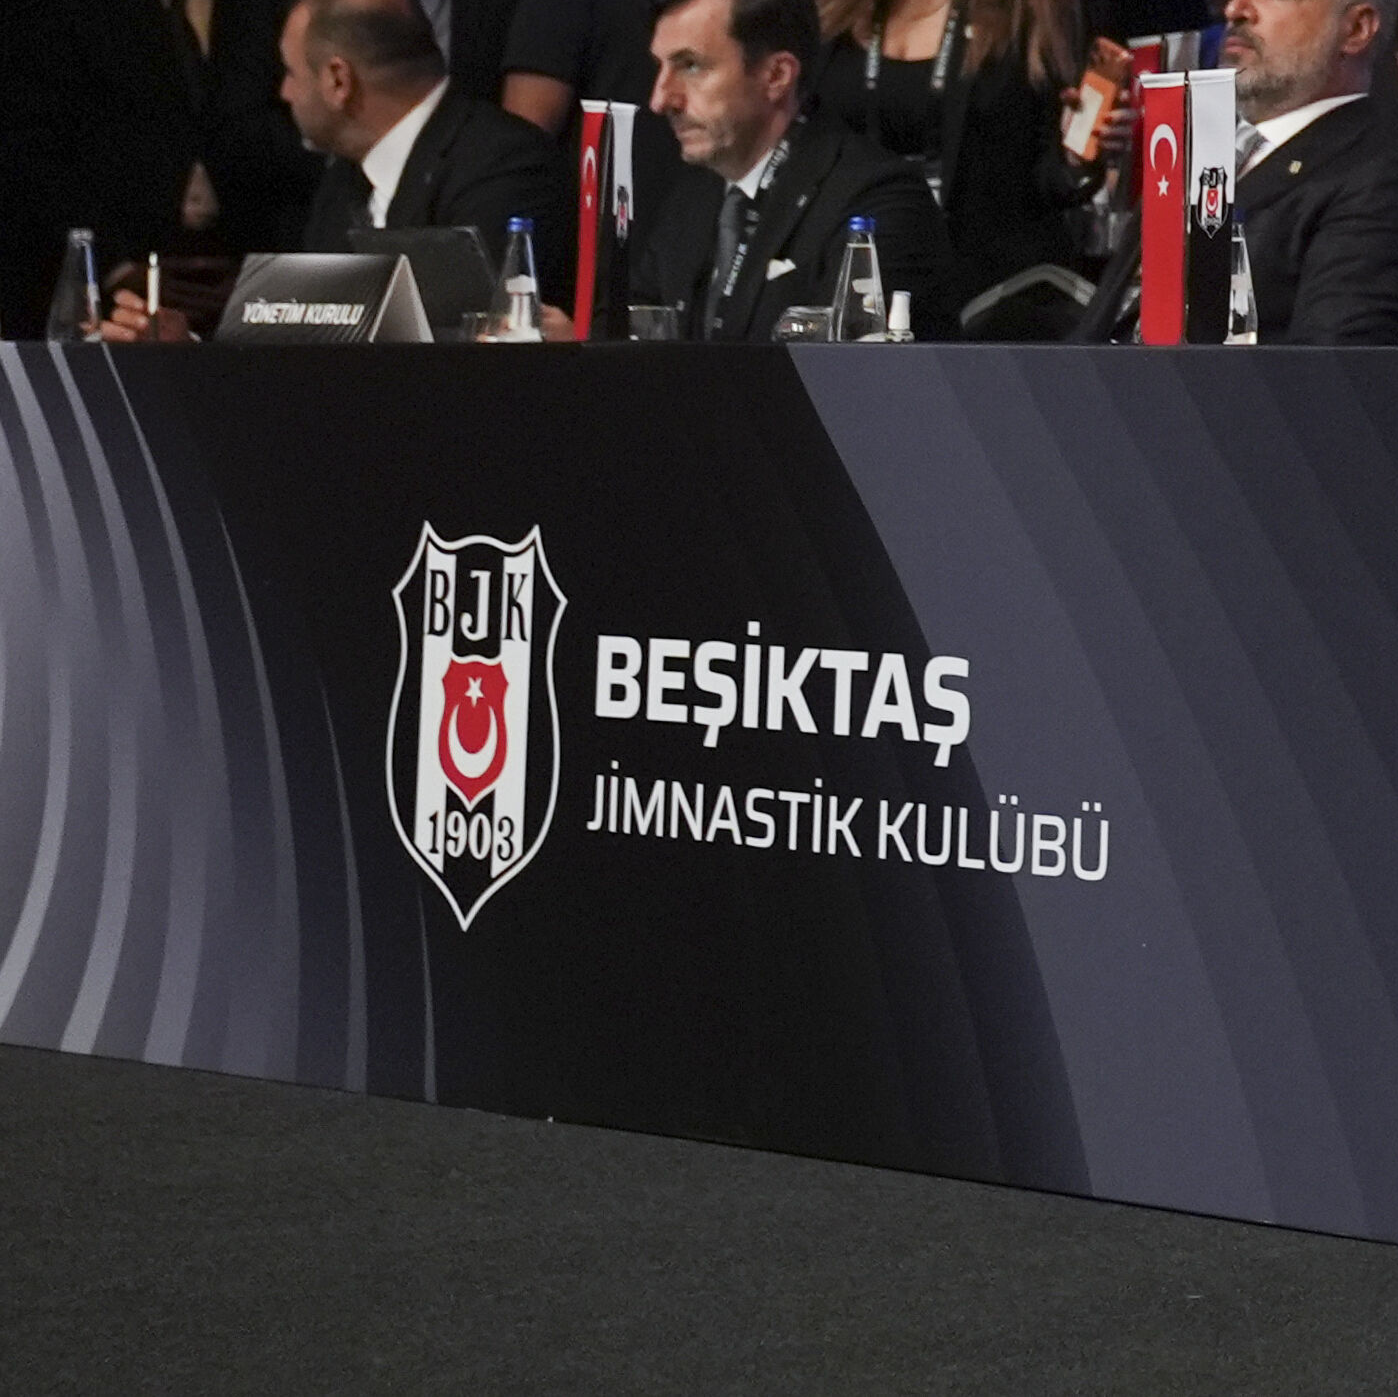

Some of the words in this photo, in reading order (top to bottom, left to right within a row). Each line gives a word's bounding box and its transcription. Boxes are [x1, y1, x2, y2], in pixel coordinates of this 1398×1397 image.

[242, 297, 307, 324] YÖNETİM
[303, 303, 365, 325] KURULU
[425, 568, 531, 643] BJK
[594, 621, 971, 767] BEŞİKTAŞ
[426, 809, 516, 862] 1903
[587, 760, 863, 858] JİMNASTİK
[877, 793, 1110, 881] KULÜBÜ
